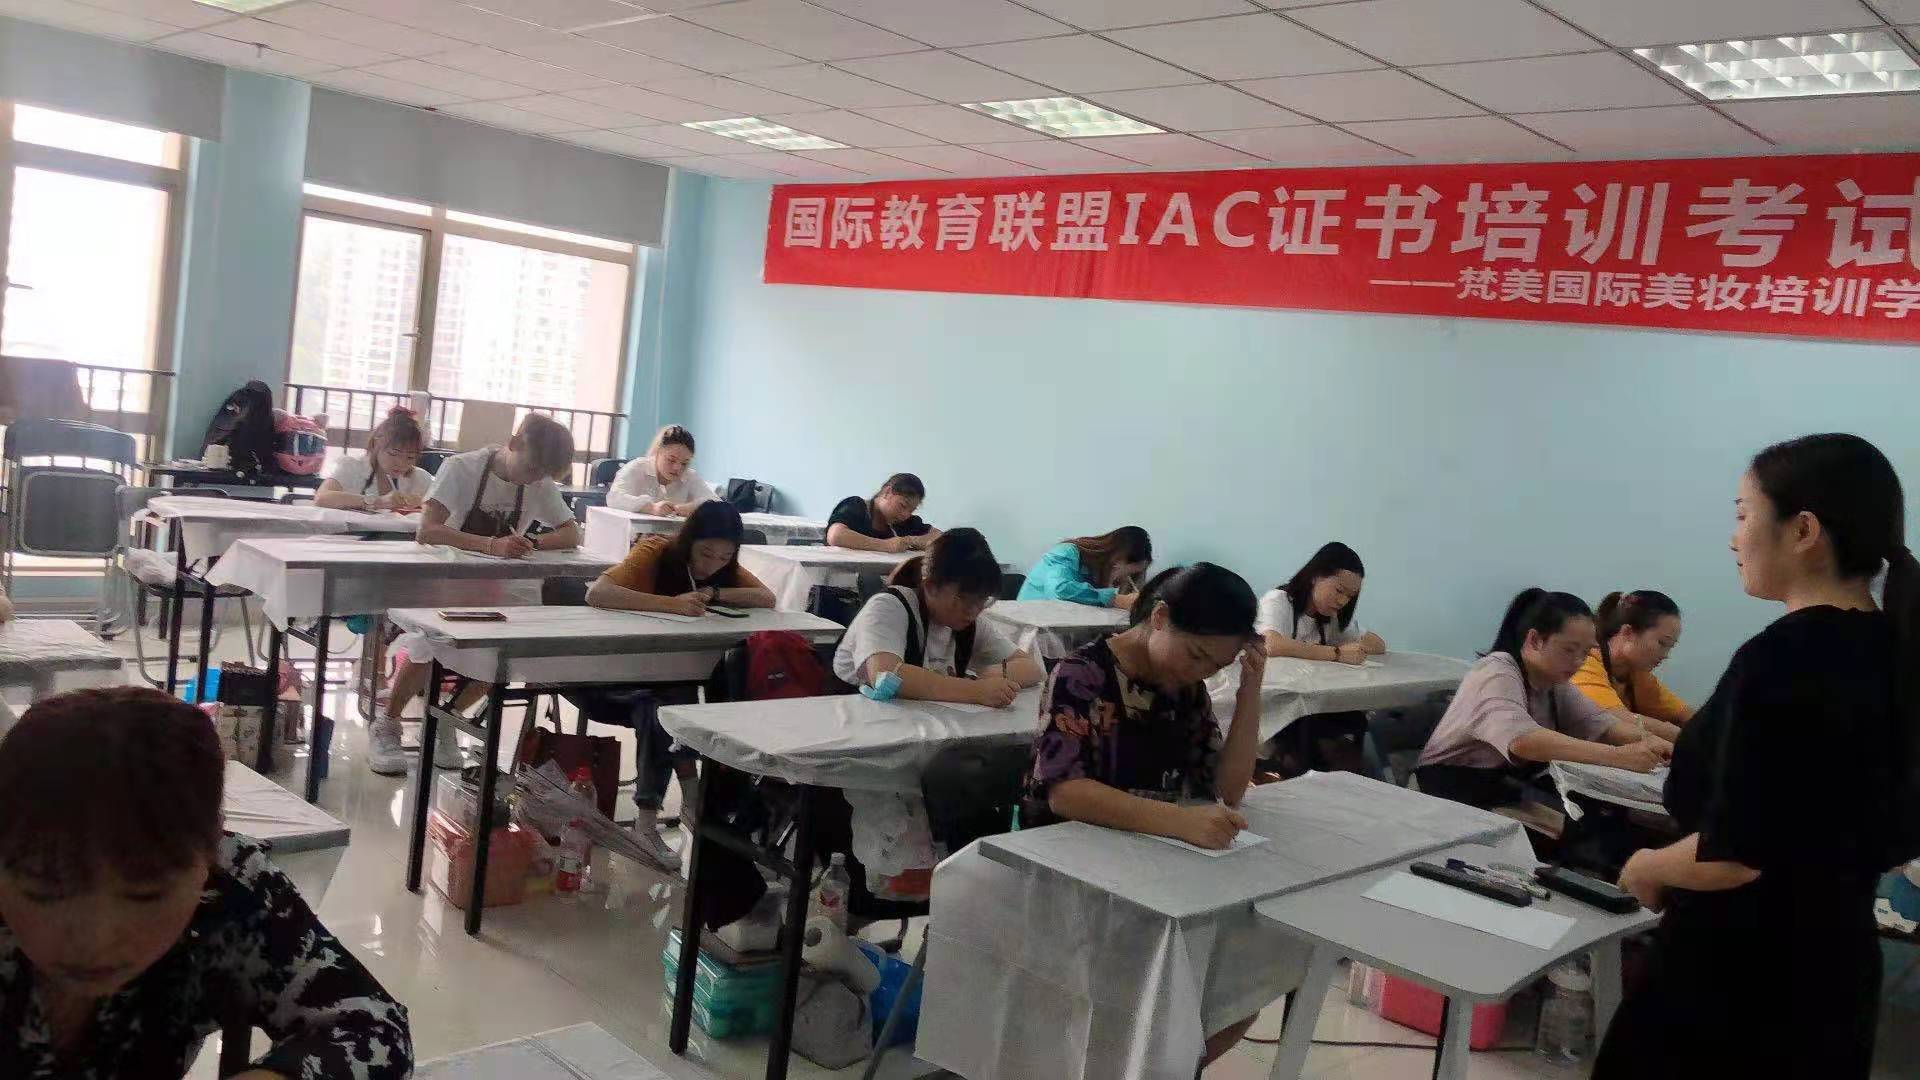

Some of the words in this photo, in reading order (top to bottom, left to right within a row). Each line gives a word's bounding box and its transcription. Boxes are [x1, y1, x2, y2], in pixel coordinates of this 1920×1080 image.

[783, 175, 1920, 271] 国际教育联盟IAC证书培训考试
